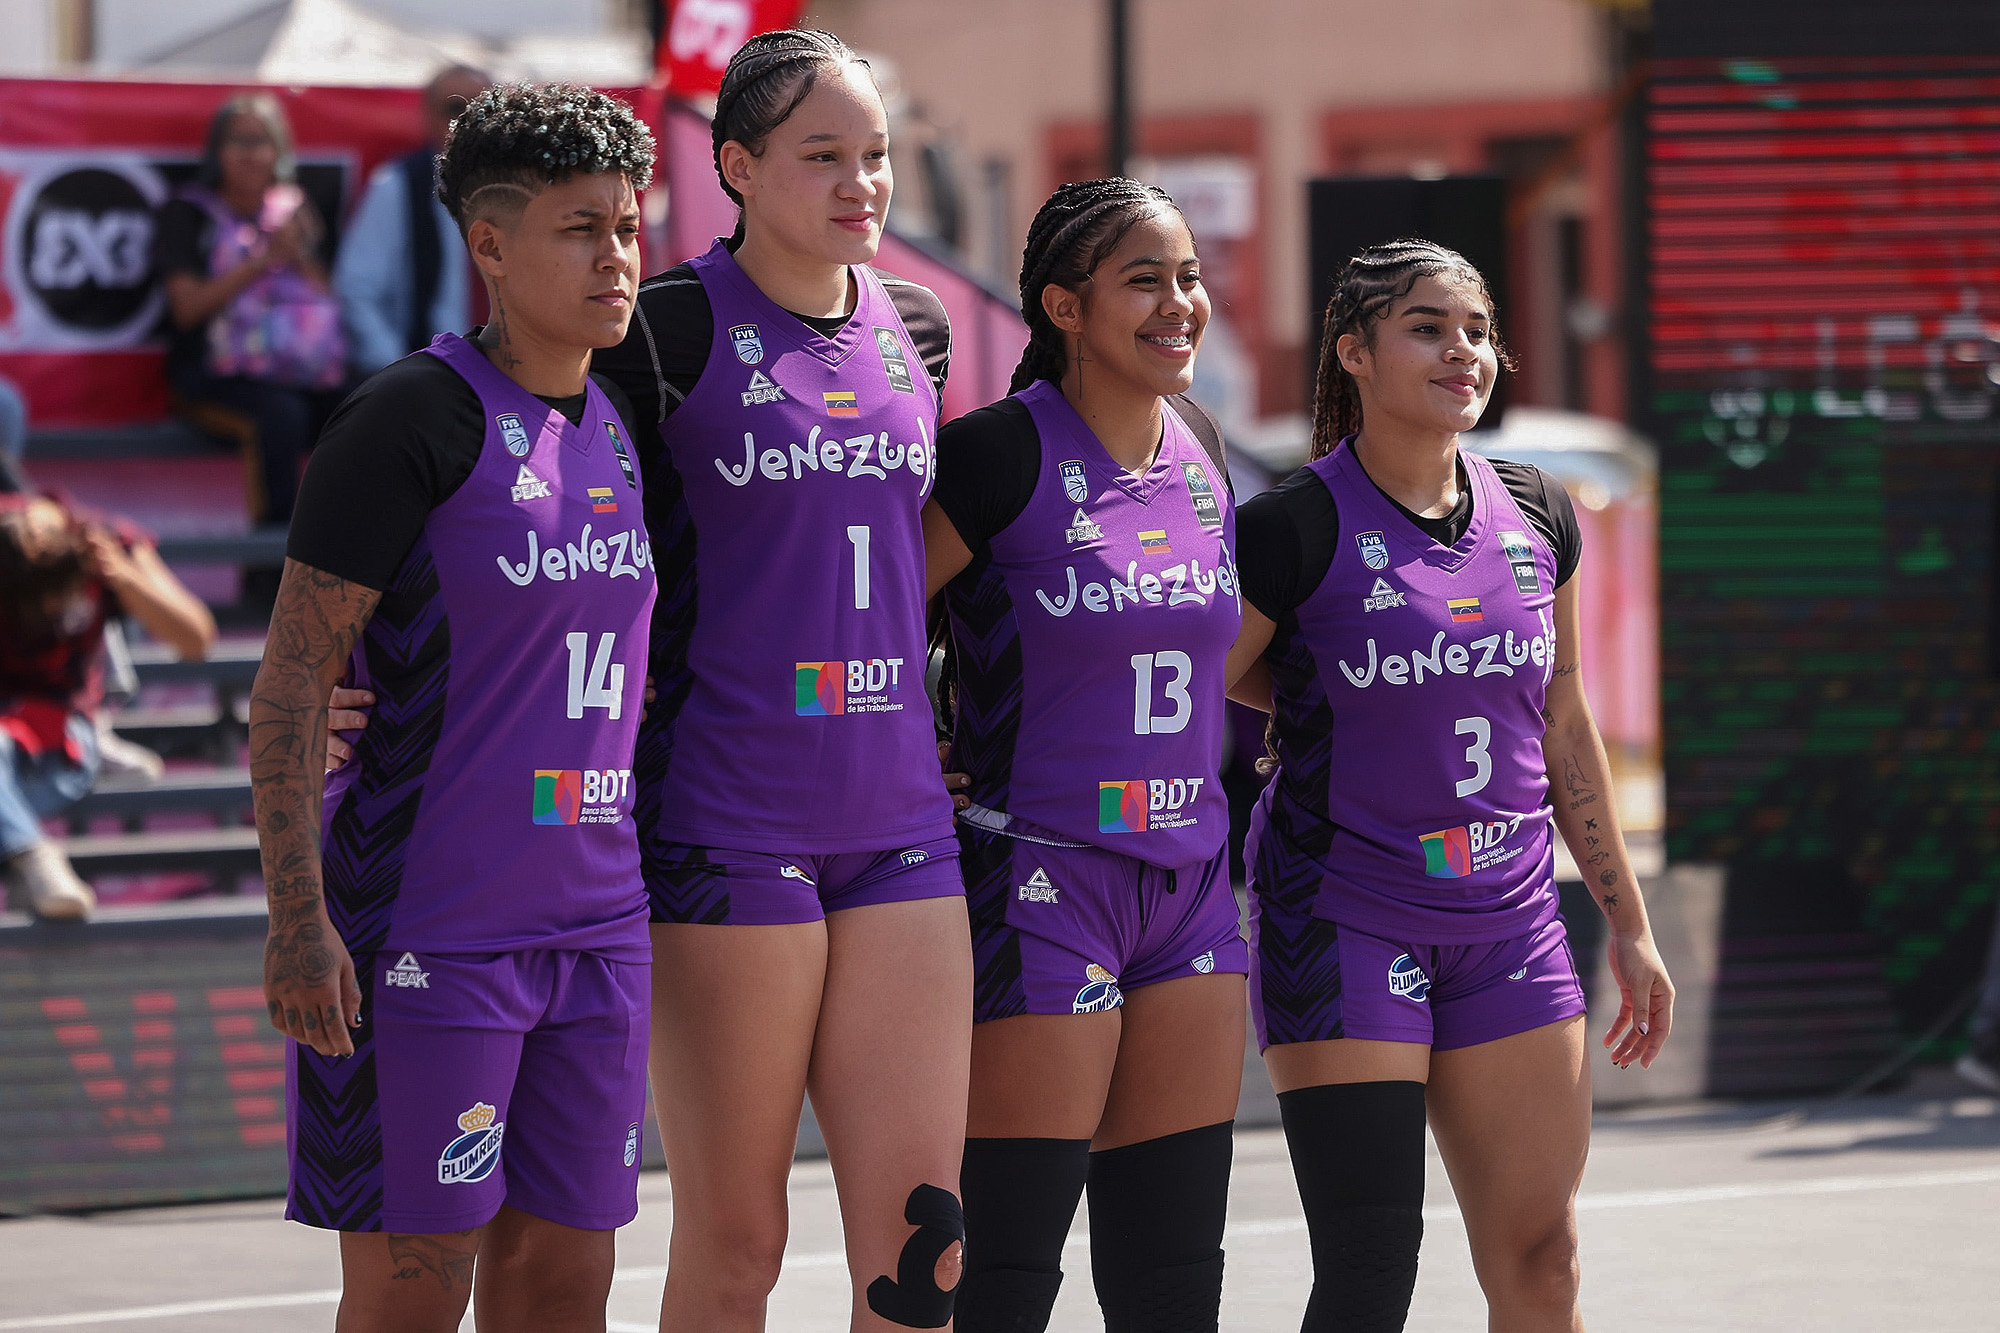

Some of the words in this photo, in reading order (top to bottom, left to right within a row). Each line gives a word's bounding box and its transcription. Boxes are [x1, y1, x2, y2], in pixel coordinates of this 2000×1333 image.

[735, 329, 756, 341] FVB
[888, 363, 907, 377] FIBA
[740, 385, 786, 407] PEAK
[502, 418, 520, 430] FVB
[1065, 466, 1081, 477] FVB
[509, 481, 553, 502] PEAK
[1196, 497, 1216, 510] FIBA
[1064, 524, 1105, 544] PEAK
[1362, 536, 1381, 546] FVB
[846, 525, 870, 610] 1
[1515, 565, 1535, 578] FIBA
[1363, 592, 1408, 613] PEAK
[566, 632, 625, 720] 14
[847, 658, 904, 692] BDT
[847, 697, 866, 705] Banco
[867, 695, 888, 705] Digital
[1130, 650, 1193, 735] 13
[857, 704, 866, 713] los
[866, 703, 904, 713] Trabajadores
[1454, 716, 1493, 798] 3
[583, 769, 631, 803] BDT
[1149, 777, 1204, 811] BDT
[579, 815, 588, 823] de
[588, 815, 598, 823] los
[581, 806, 600, 815] Banco
[1149, 822, 1159, 830] de
[1469, 812, 1525, 853] BDT
[1473, 853, 1489, 864] Banco
[1473, 864, 1481, 872] de
[1481, 860, 1490, 869] los
[1490, 846, 1524, 866] Trabajadores
[1018, 885, 1060, 904] PEAK
[385, 970, 430, 988] PEAK
[627, 1127, 638, 1140] FVB
[442, 1126, 502, 1180] PLUMROSE
